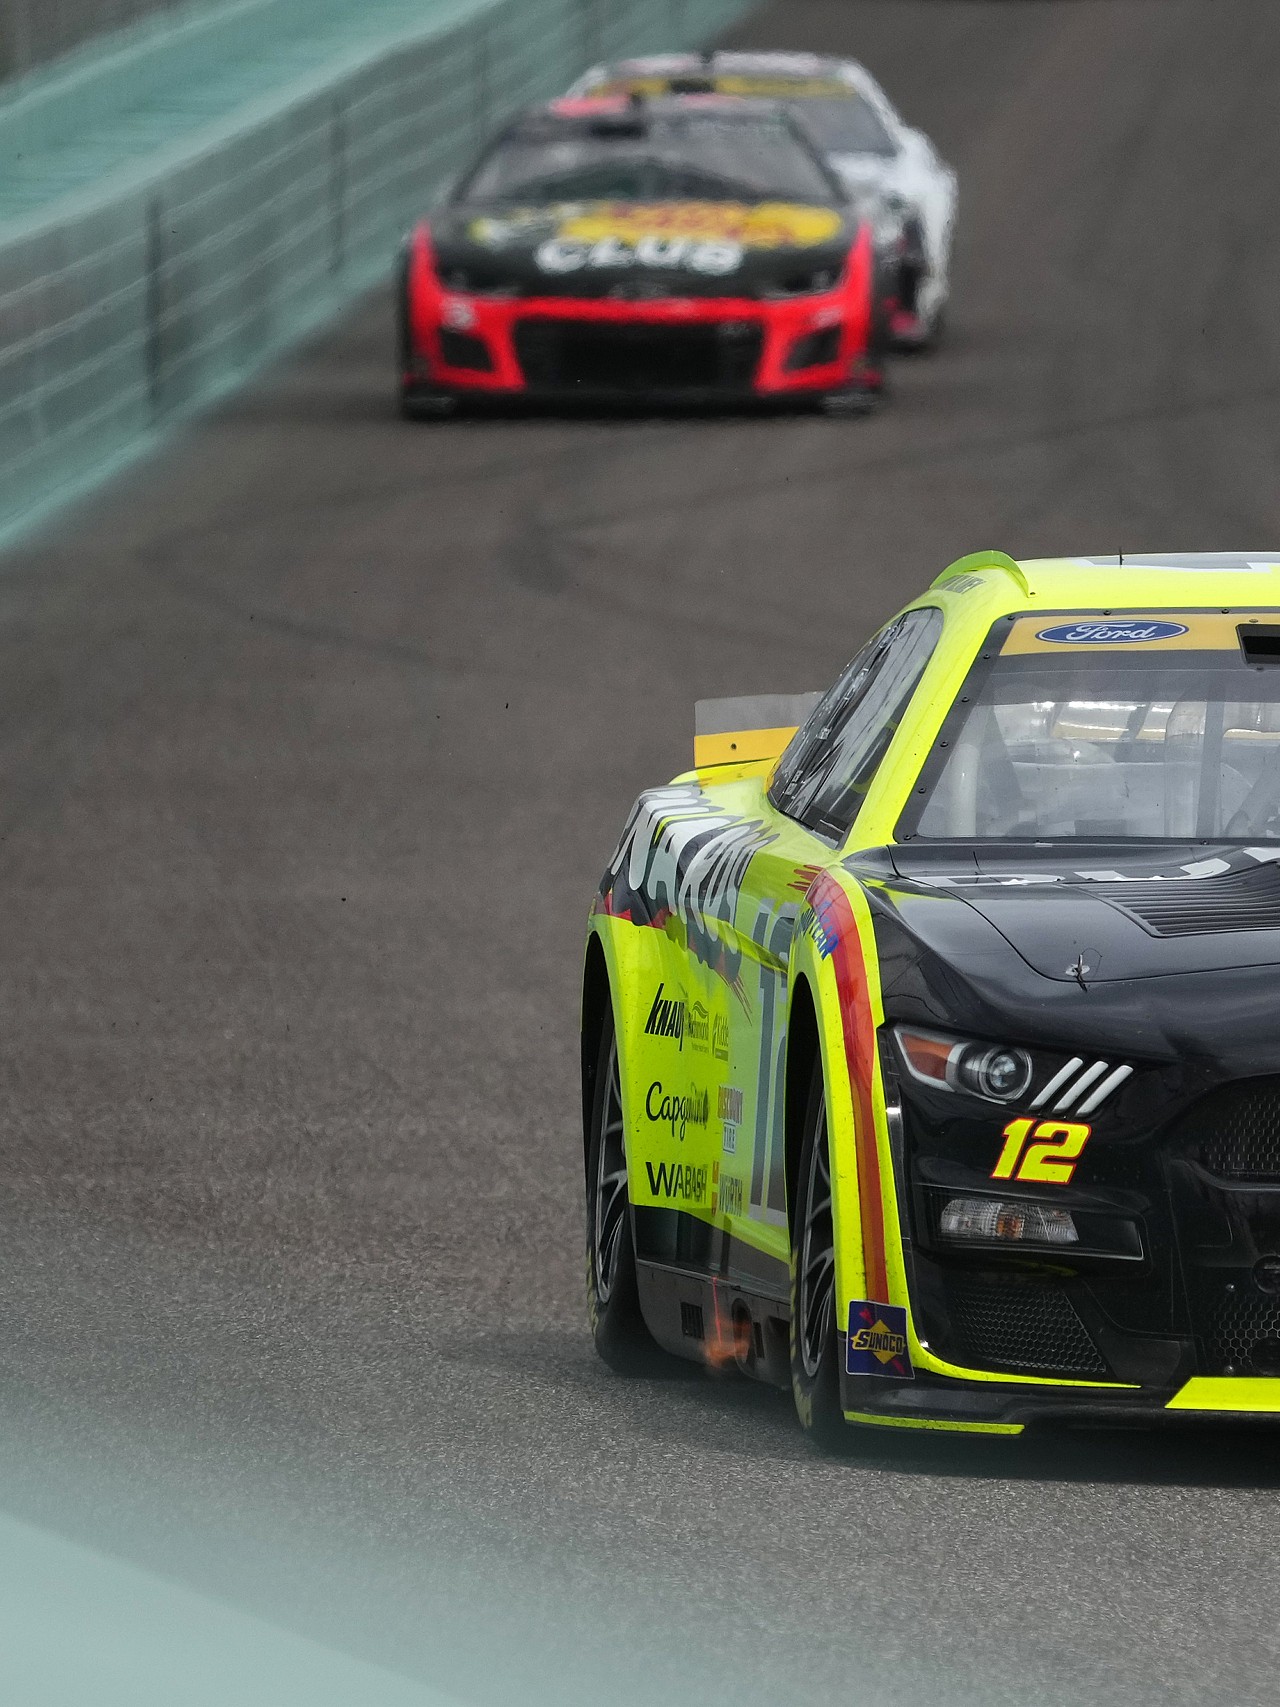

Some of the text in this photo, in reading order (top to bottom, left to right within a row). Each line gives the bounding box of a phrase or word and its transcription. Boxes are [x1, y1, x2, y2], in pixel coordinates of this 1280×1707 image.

[1066, 623, 1158, 640] Ford
[990, 1116, 1092, 1185] 12
[854, 1330, 905, 1354] SUNOCO
